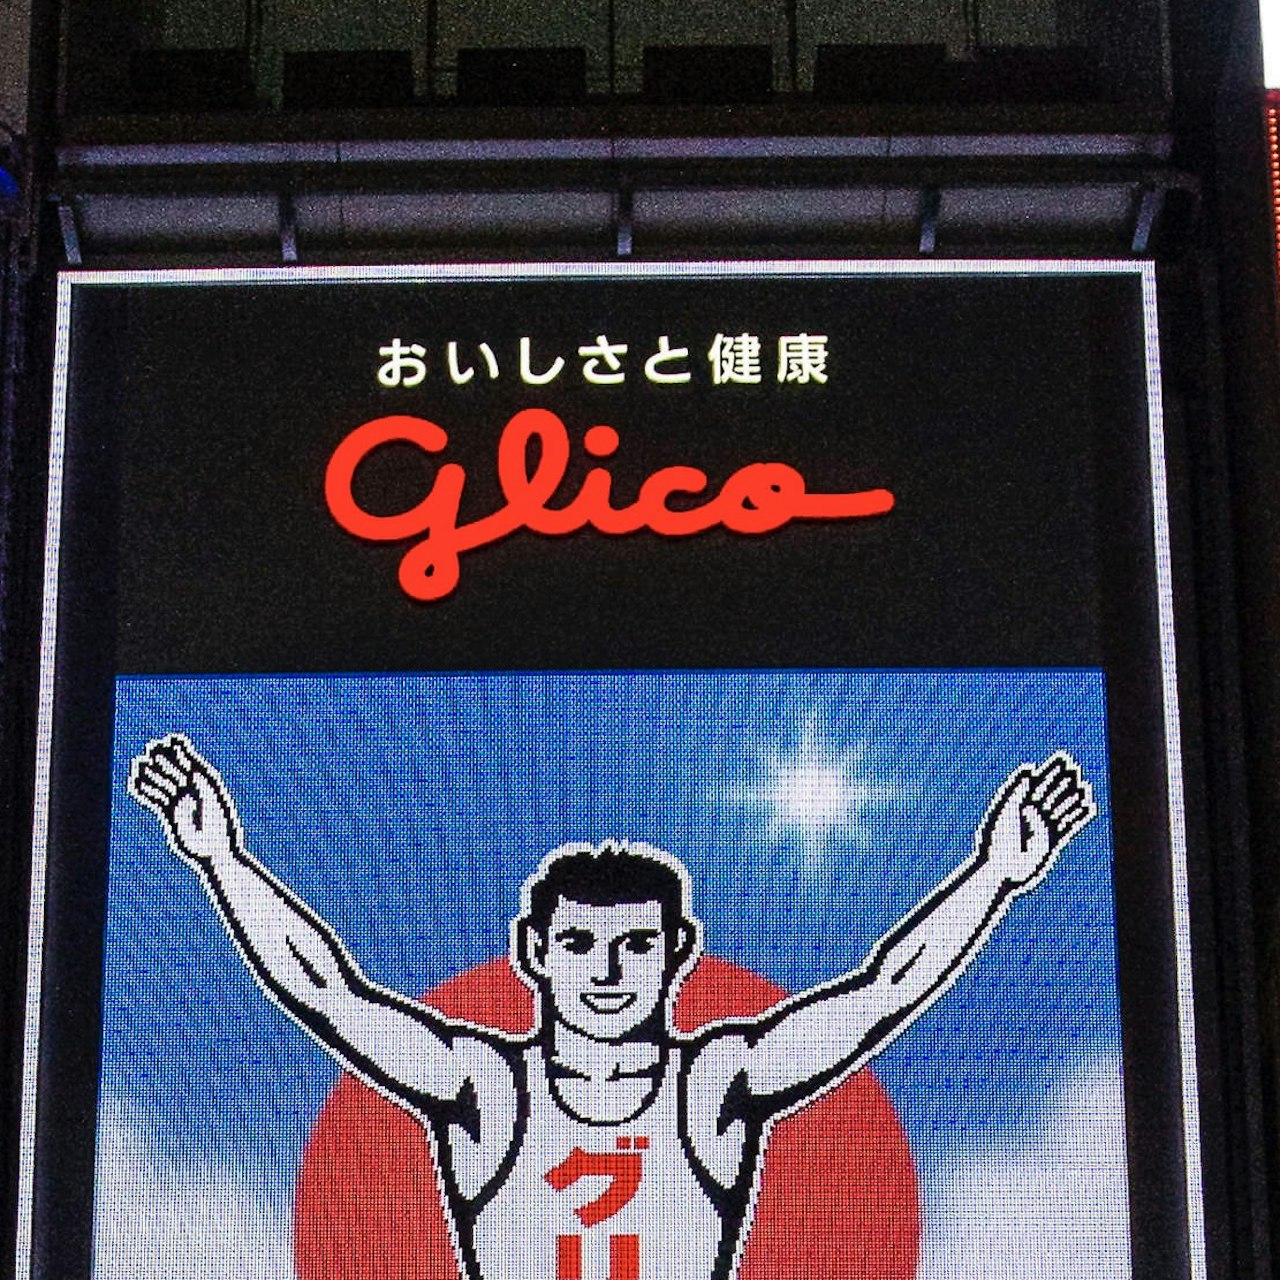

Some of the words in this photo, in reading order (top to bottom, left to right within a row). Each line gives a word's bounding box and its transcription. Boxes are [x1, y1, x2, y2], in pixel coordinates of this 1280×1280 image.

[377, 332, 831, 388] おいしさと健康
[324, 408, 896, 602] Glico
